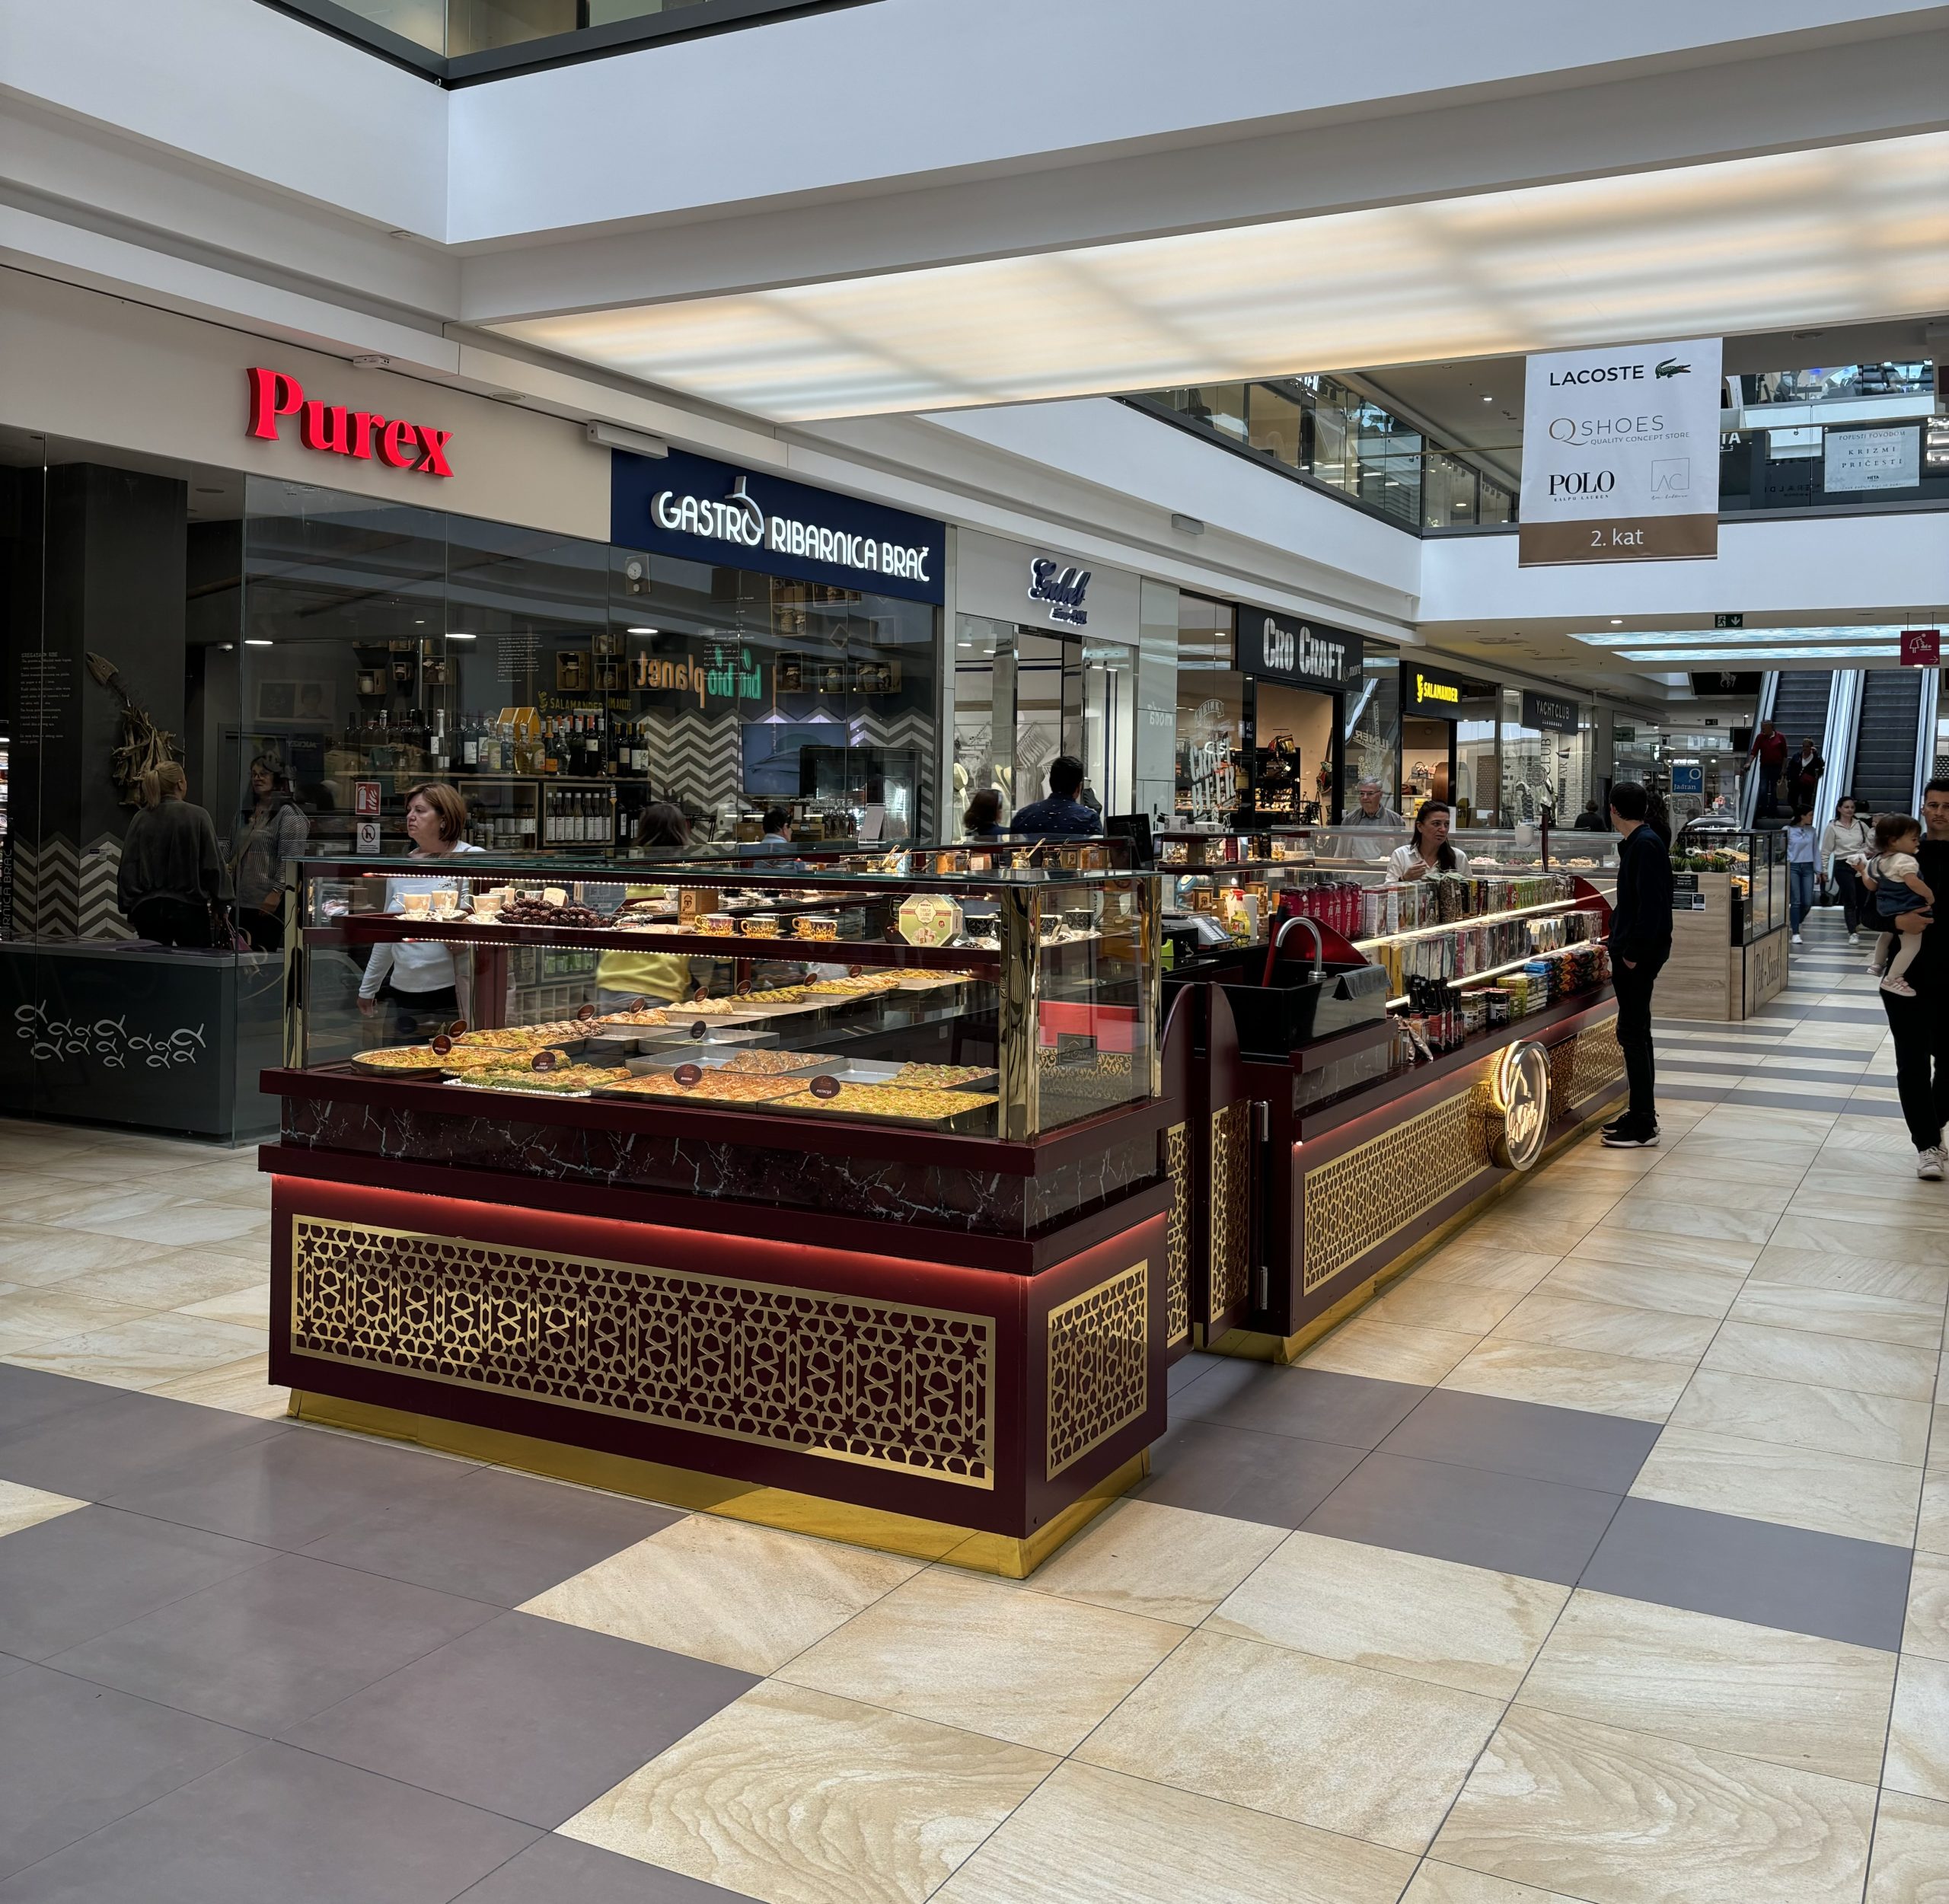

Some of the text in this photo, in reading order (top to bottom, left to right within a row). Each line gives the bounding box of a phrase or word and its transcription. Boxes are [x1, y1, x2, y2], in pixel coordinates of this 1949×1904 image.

[1549, 365, 1644, 386] LACOSTE
[245, 367, 455, 477] Purex
[1590, 432, 1690, 445] QUALITY CONCEPT STORE
[1849, 446, 1896, 455] KRIZMI
[1842, 458, 1903, 468] PRIČESTI
[1549, 470, 1616, 496] POLO
[653, 488, 930, 582] GASTRO RIBARNICA BRAČ
[1590, 528, 1644, 547] 2. kat
[1299, 627, 1345, 681] CRAFT
[1424, 682, 1459, 703] SALAMANDER
[1541, 738, 1552, 776] CLUB
